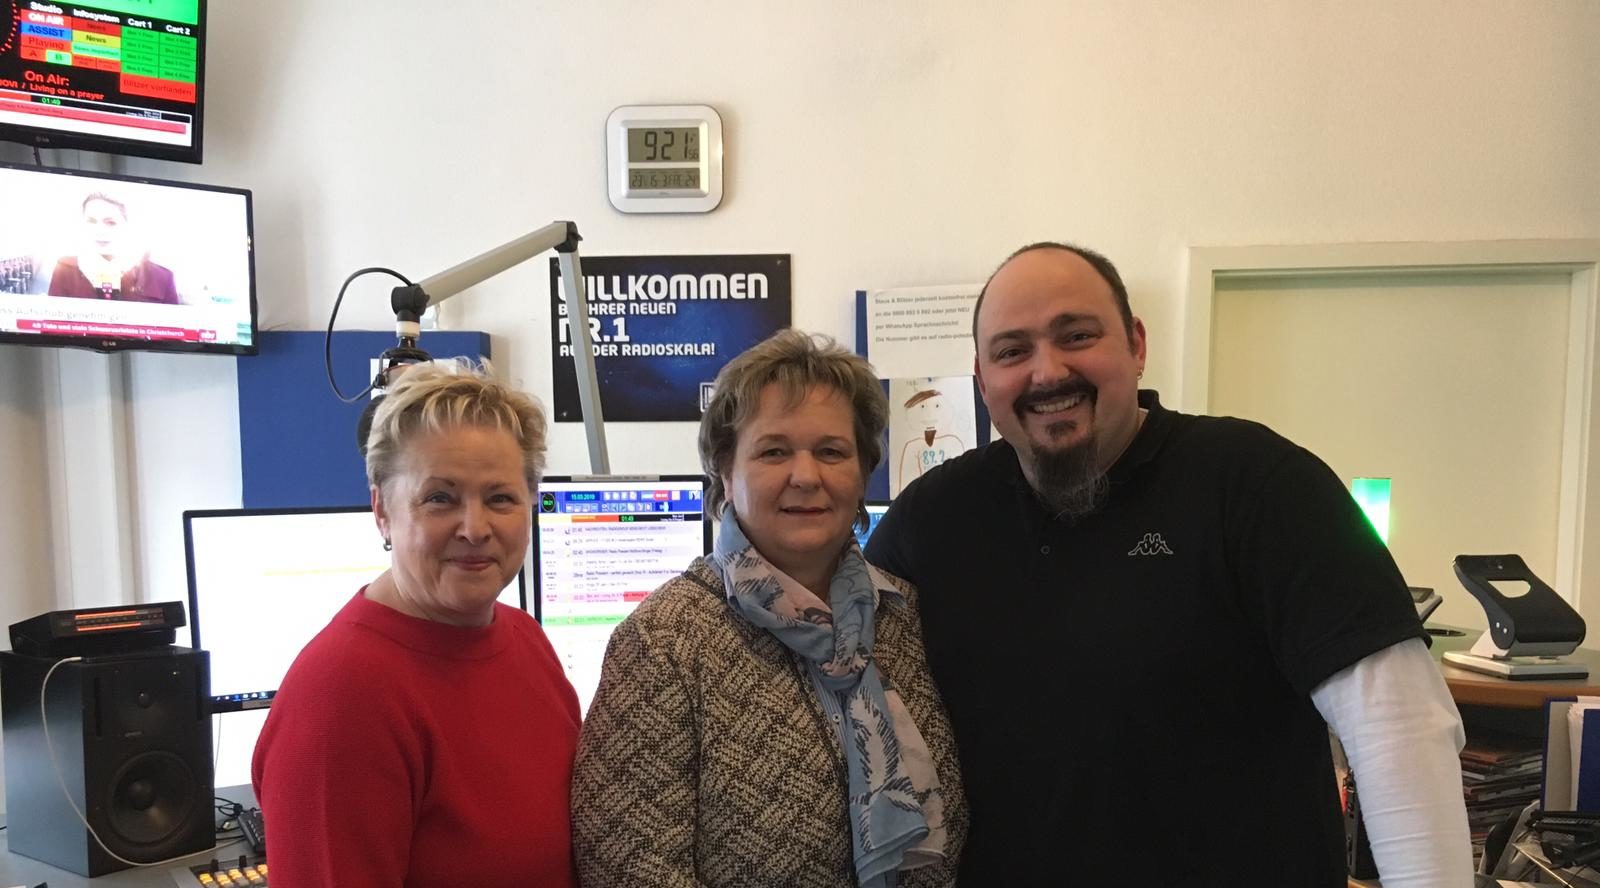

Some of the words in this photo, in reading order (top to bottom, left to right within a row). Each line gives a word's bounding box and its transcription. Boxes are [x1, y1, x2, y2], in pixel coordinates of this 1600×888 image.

[127, 18, 147, 28] Cart
[166, 24, 184, 34] Cart
[28, 25, 65, 38] ASSIST
[28, 37, 65, 50] Playing
[24, 70, 45, 83] On
[46, 73, 70, 86] Air:
[30, 83, 55, 95] Living
[57, 87, 68, 95] on
[77, 90, 105, 100] prayer
[586, 302, 626, 316] HRER
[629, 302, 677, 316] NEUEN
[592, 344, 619, 357] DER
[621, 342, 715, 356] RADIOSKALA!
